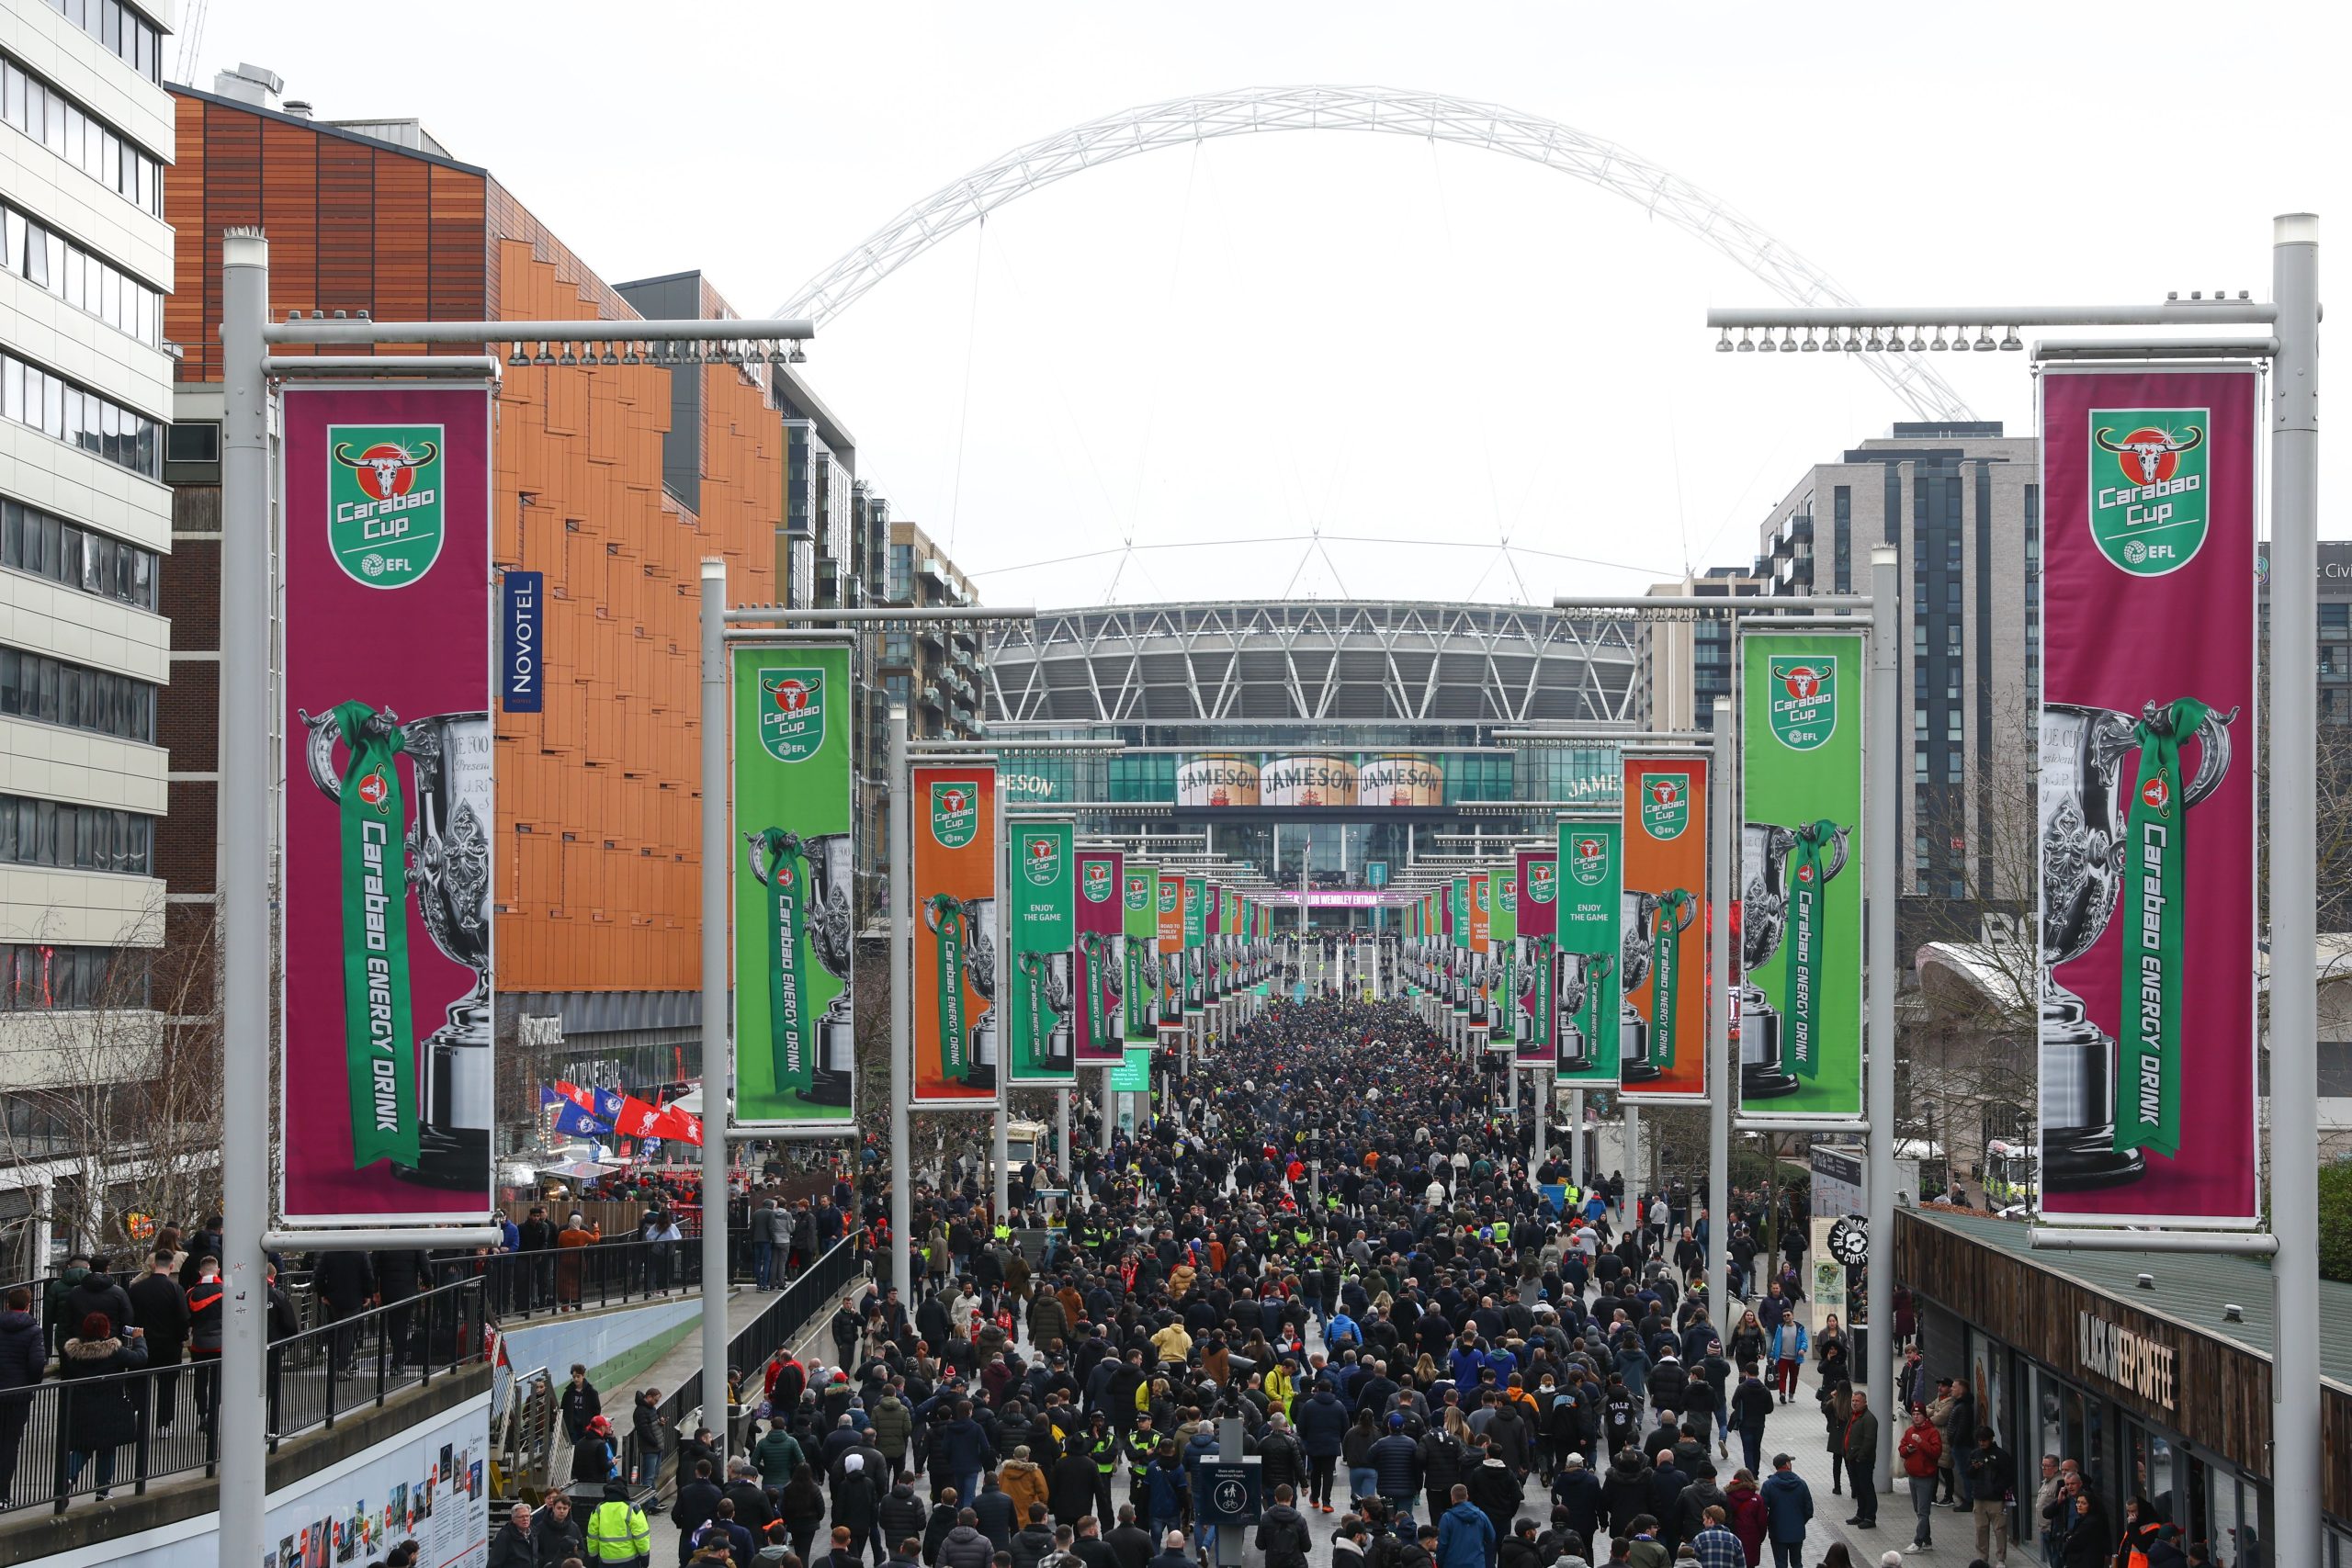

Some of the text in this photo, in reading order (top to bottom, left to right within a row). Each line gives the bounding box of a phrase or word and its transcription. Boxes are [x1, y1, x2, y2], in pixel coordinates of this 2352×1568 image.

[2098, 474, 2200, 510] Carabao
[337, 489, 435, 524] Carabao
[2126, 502, 2173, 526] Cup
[364, 516, 409, 540] Cup
[2149, 546, 2176, 558] EFL
[386, 558, 412, 571] EFL
[513, 581, 532, 693] NOVOTEL
[1774, 694, 1832, 712] Carabao
[763, 705, 820, 725] Carabao
[1790, 709, 1816, 722] Cup
[779, 721, 805, 735] Cup
[1802, 732, 1818, 741] EFL
[791, 744, 807, 753] EFL
[1005, 773, 1054, 796] ESON
[1181, 768, 1256, 793] JAMESON
[1265, 766, 1353, 795] JAMESON
[1363, 768, 1439, 793] JAMESON
[935, 808, 974, 822] Carabao
[1645, 799, 1686, 814] Carabao
[1656, 811, 1675, 820] Cup
[945, 819, 964, 829] Cup
[1026, 854, 1057, 865] Carabao
[1574, 853, 1605, 865] Carabao
[1030, 904, 1054, 912] ENJOY
[1321, 895, 1352, 905] WEMBLEY
[1577, 904, 1601, 912] ENJOY
[1023, 913, 1061, 921] THE GAME
[362, 819, 399, 1134] Carabao ENERGY DRINK
[778, 894, 799, 1073] Carabao ENERGY DRINK
[1794, 889, 1814, 1063] Carabao ENERGY DRINK
[2138, 820, 2168, 1127] Carabao ENERGY DRINK
[944, 941, 960, 1066] Carabao ENERGY DRINK
[1658, 936, 1671, 1058] Carabao ENERGY DRINK
[518, 1012, 565, 1047] NOVOTEL
[1833, 1224, 1850, 1247] BLAC
[2079, 1310, 2175, 1411] BLACK SHEEP COFFEE
[1610, 1402, 1630, 1410] YALE
